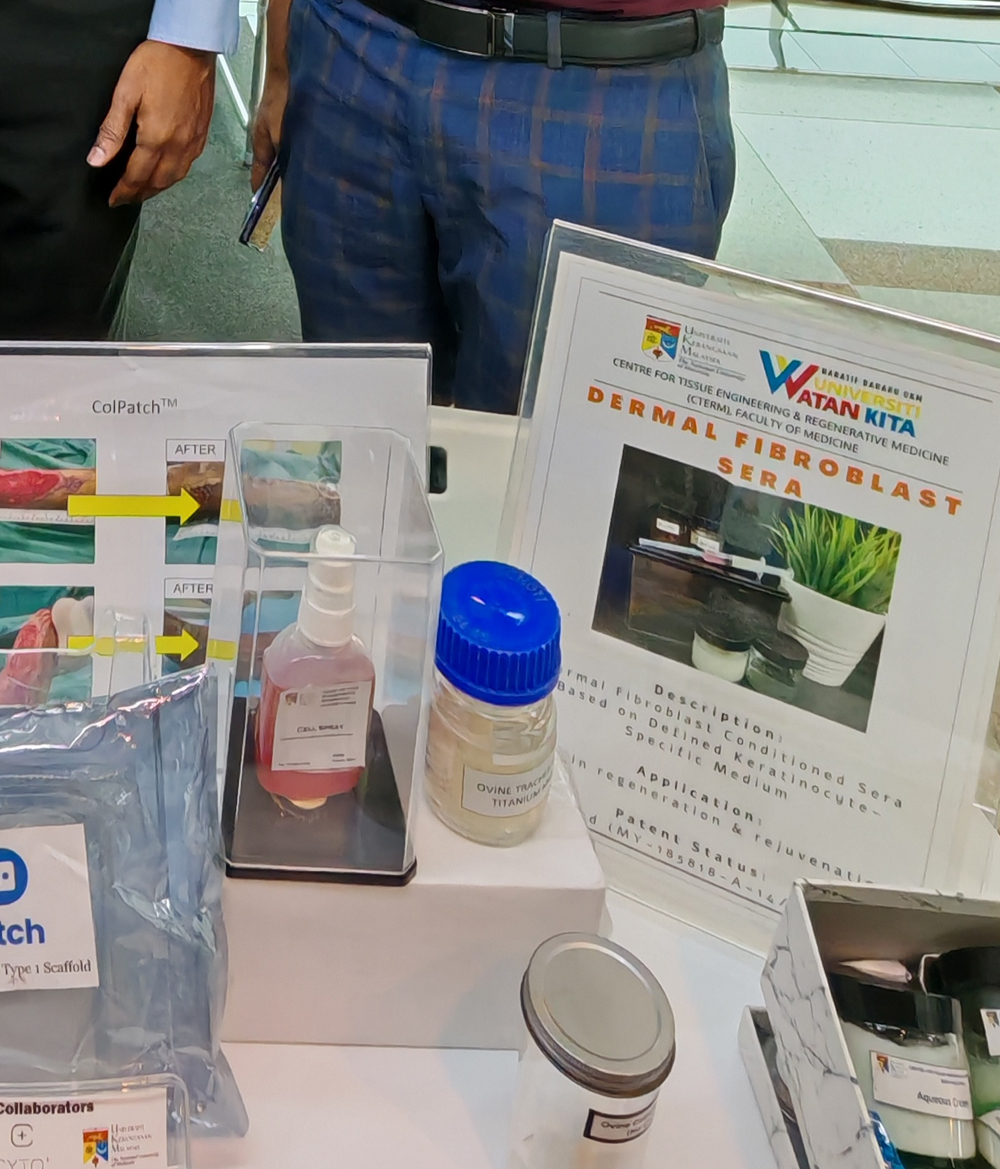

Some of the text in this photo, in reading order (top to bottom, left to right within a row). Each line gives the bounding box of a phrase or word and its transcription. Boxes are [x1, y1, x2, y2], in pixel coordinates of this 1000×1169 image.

[612, 357, 652, 376] CENTRE
[654, 369, 675, 384] FOR
[678, 376, 713, 395] TISSUE
[715, 388, 790, 419] ENGINEERING
[794, 410, 801, 421] &
[804, 414, 888, 448] REGENERATIVE
[891, 440, 950, 466] MEDICINE
[814, 377, 921, 419] UNIVERSITI
[735, 407, 782, 431] FACULTY
[785, 423, 800, 435] OF
[803, 428, 859, 454] MEDICINE
[864, 407, 916, 438] KITA
[174, 443, 216, 456] AFTER
[587, 385, 963, 517] DERMAL FIBROBLAST
[717, 456, 803, 499] SERA
[173, 582, 214, 594] AFTER
[557, 681, 608, 708] Based
[618, 707, 638, 721] on
[648, 717, 722, 755] Defined
[655, 683, 783, 743] Description:
[616, 686, 712, 734] Fibroblast
[724, 729, 845, 786] Conditioned
[858, 782, 902, 808] Sera
[625, 725, 788, 800] Specific Medium
[476, 782, 512, 796] OVINE
[597, 767, 721, 826] regeneration
[732, 823, 743, 836] &
[636, 765, 762, 826] Application:
[615, 808, 681, 845] Patent
[2, 962, 32, 981] Type
[43, 958, 91, 974] Scaffold
